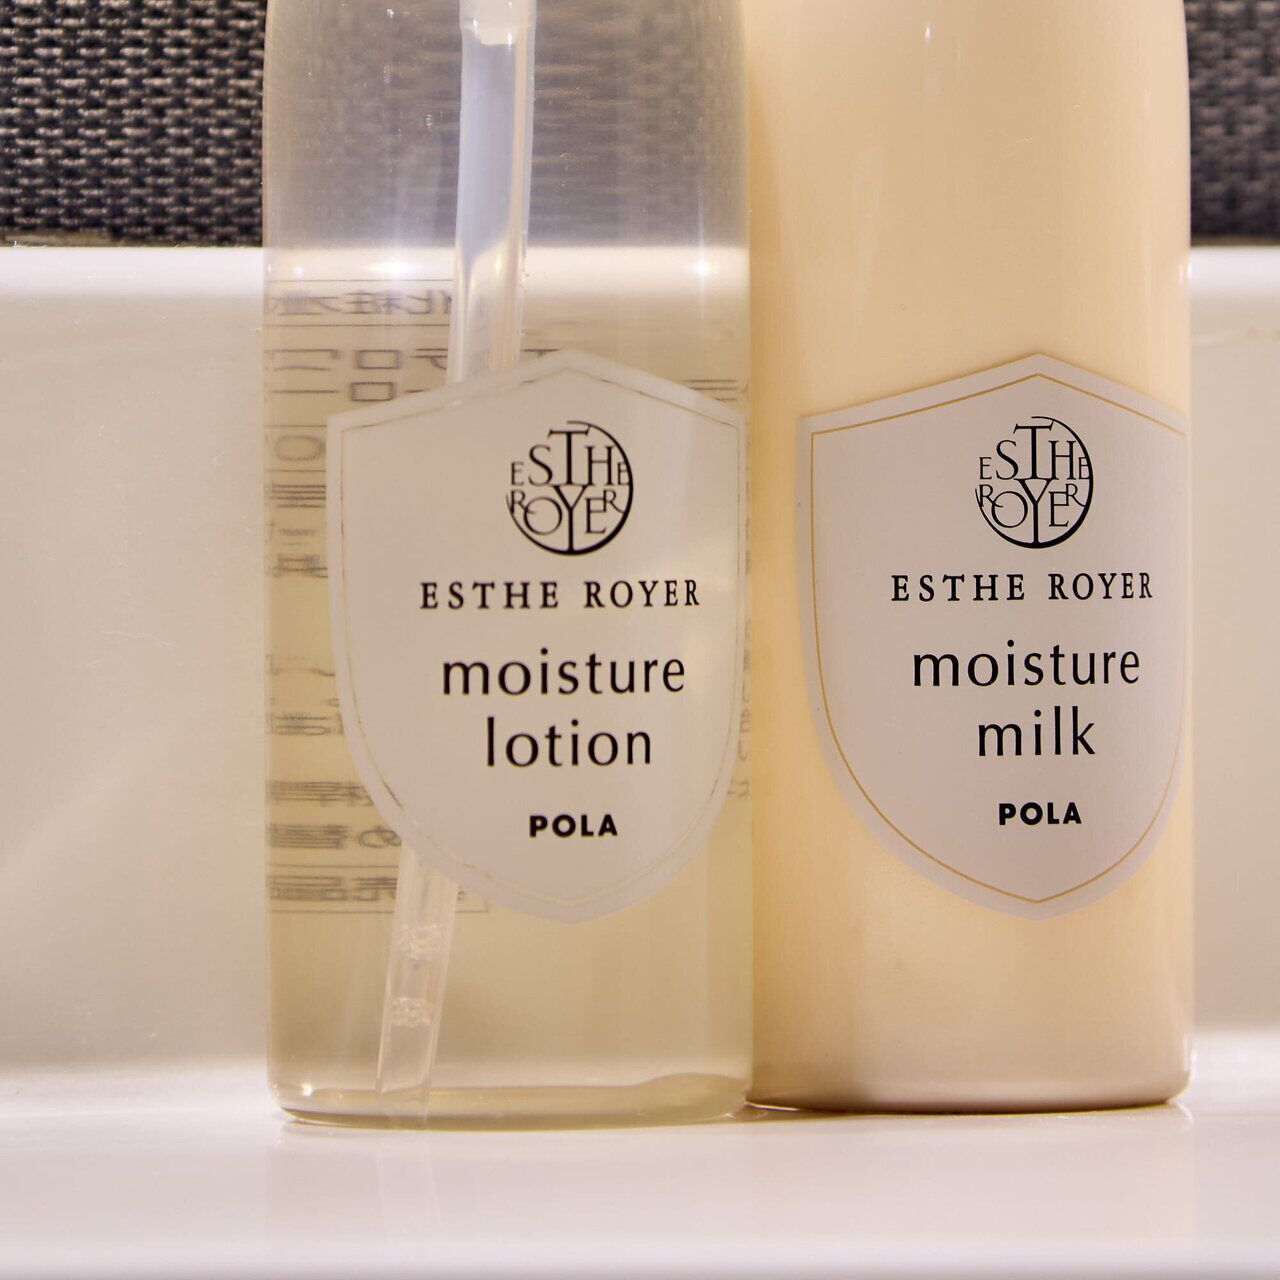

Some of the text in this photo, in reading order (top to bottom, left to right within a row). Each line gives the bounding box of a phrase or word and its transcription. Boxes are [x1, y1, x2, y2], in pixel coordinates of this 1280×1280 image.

[510, 428, 631, 486] ESTHE
[978, 422, 1091, 480] ESTHE
[508, 484, 623, 553] ROYER
[977, 478, 1086, 547] ROYER
[419, 579, 701, 610] ESTHE ROYER
[890, 571, 1154, 603] ESTHE ROYER
[442, 647, 686, 696] moisture
[912, 638, 1141, 687] moisture
[486, 716, 652, 768] lotion
[977, 705, 1096, 757] milk
[528, 813, 618, 839] POLA
[998, 801, 1083, 826] POLA
